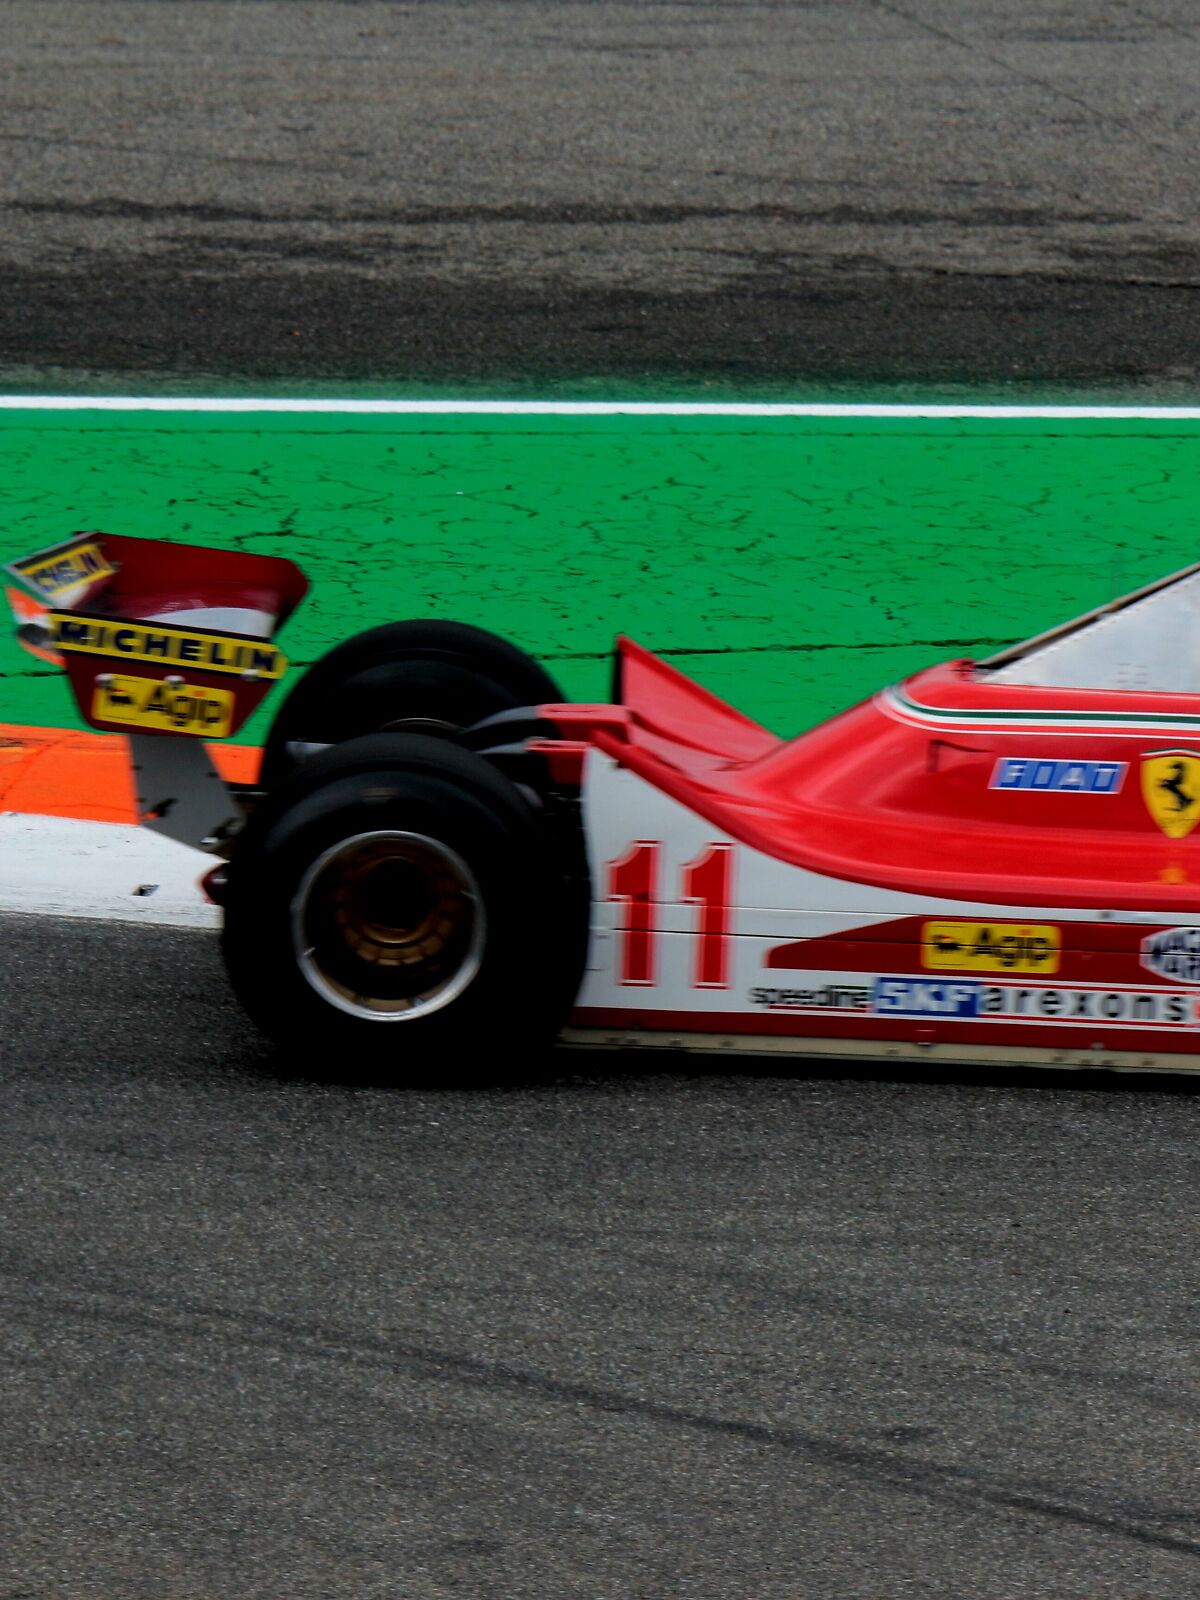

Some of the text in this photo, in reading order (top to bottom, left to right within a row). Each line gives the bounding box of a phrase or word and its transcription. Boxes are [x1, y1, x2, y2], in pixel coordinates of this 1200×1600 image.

[58, 619, 278, 673] MICHELIN
[144, 685, 226, 729] Agip
[1005, 763, 1119, 789] FIAT
[604, 839, 736, 990] 11
[969, 927, 1050, 969] Agip
[878, 981, 975, 1014] SKF
[982, 985, 1187, 1022] arexons
